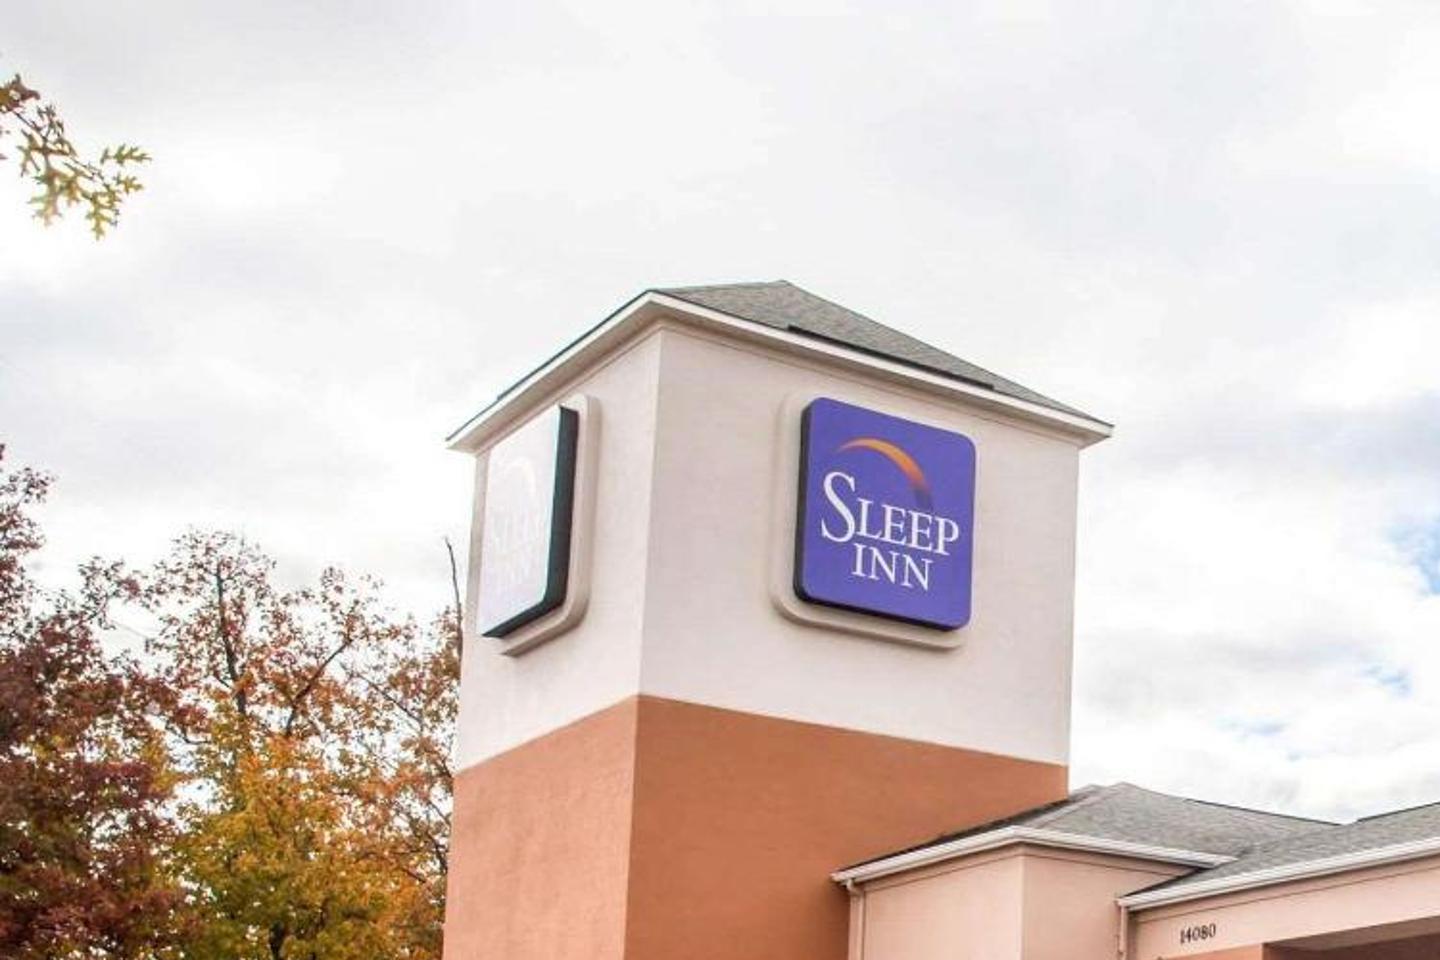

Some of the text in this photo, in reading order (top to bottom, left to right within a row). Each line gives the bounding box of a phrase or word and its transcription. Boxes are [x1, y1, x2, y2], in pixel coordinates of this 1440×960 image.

[821, 471, 959, 556] SLEEP
[852, 542, 933, 591] INN
[1180, 923, 1216, 944] 14080
